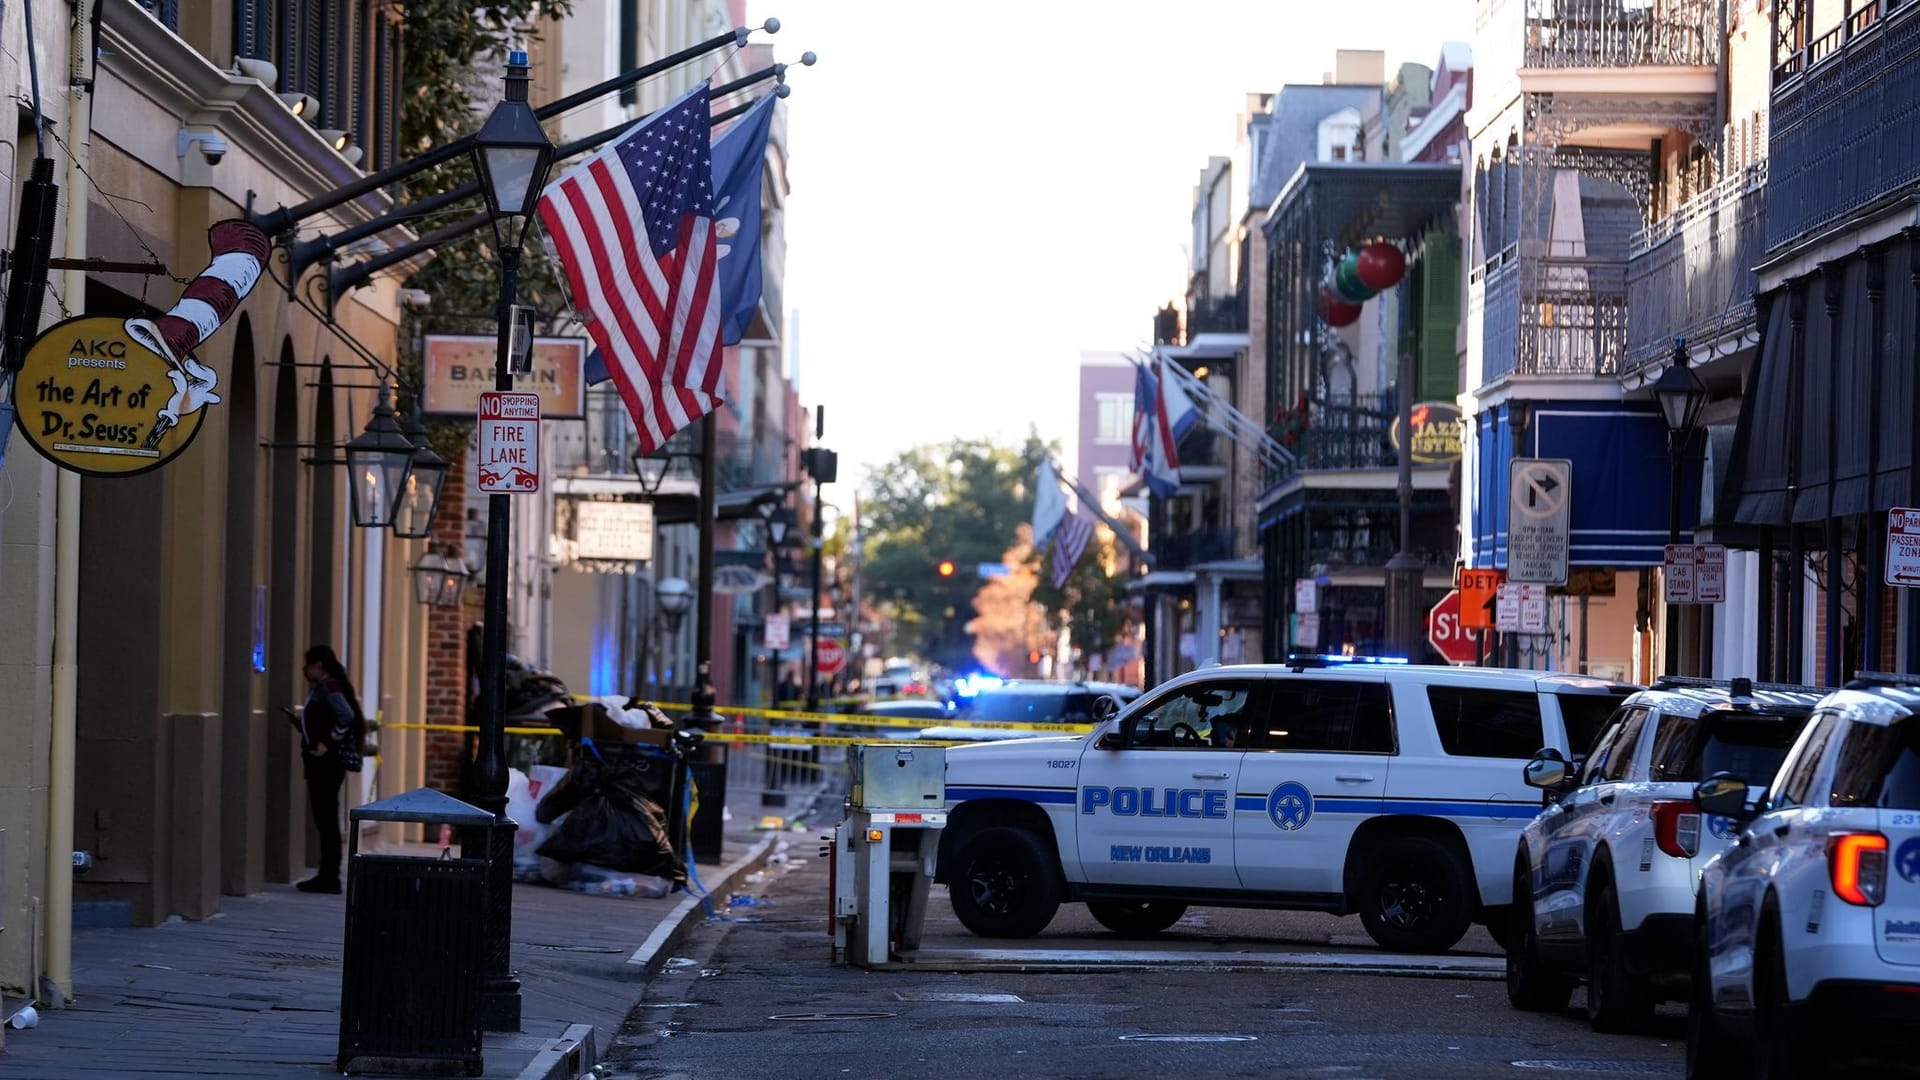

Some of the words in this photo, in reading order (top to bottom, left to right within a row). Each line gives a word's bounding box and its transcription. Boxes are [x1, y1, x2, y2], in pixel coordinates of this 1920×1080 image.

[68, 356, 126, 370] presents
[36, 376, 74, 404] the
[81, 378, 123, 408] Art
[127, 383, 152, 409] of
[481, 396, 501, 416] NO
[503, 407, 535, 417] ANYTIME
[41, 411, 75, 440] Dr.
[493, 426, 525, 442] FIRE
[491, 447, 527, 463] LANE
[1890, 513, 1904, 528] NO
[1891, 535, 1920, 546] PASSEN
[1673, 567, 1687, 577] CAB
[1669, 580, 1691, 590] STAND
[1047, 760, 1076, 768] 18027
[1082, 786, 1228, 819] POLICE
[1110, 845, 1143, 862] NEW
[1145, 846, 1211, 864] ORLEANS
